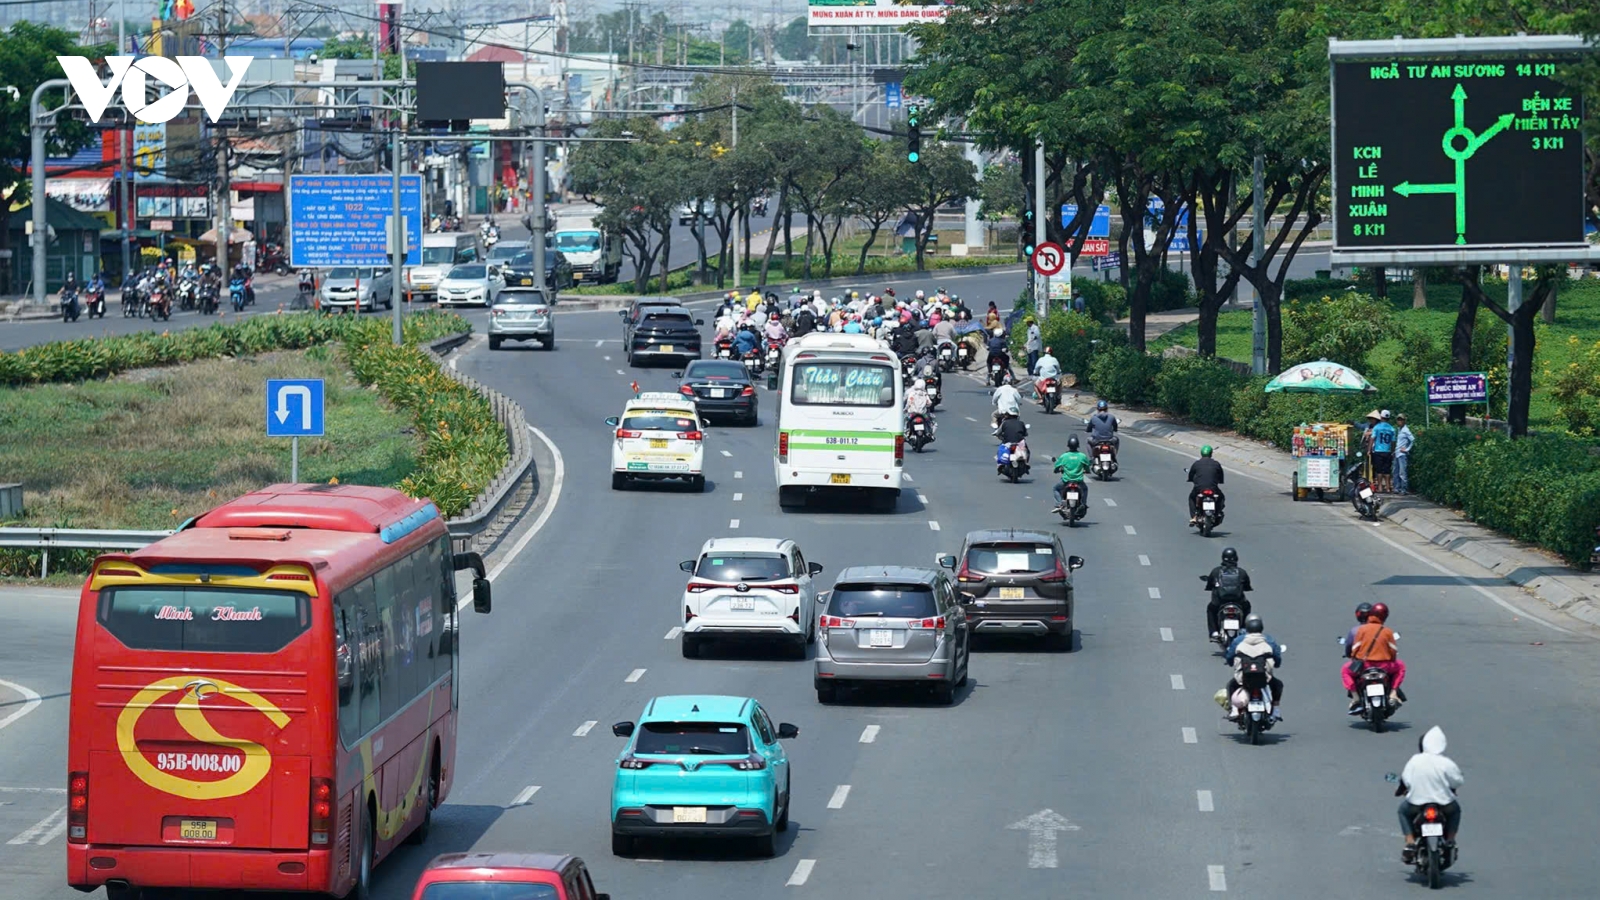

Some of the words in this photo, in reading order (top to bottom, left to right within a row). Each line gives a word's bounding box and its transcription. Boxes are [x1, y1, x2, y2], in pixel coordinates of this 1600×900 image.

[1370, 63, 1400, 79] NGÃ
[1407, 64, 1428, 78] TƯ
[1431, 66, 1451, 78] AN
[1455, 64, 1506, 78] SƯƠNG
[1516, 64, 1531, 76] 14
[1535, 64, 1555, 76] KM
[1522, 90, 1550, 111] BẾN
[1554, 98, 1572, 110] XE
[1515, 111, 1548, 130] MIỀN
[1552, 114, 1580, 129] TÂY
[1532, 138, 1540, 149] 3
[1544, 137, 1564, 149] KM
[1353, 146, 1382, 158] KCN
[1358, 162, 1378, 178] LÊ
[1351, 184, 1384, 197] MINH
[1348, 200, 1387, 216] XUÂN
[1353, 224, 1361, 236] 8
[1365, 224, 1385, 236] KM
[1096, 242, 1107, 252] SÁT
[806, 366, 838, 383] Thảo
[845, 370, 883, 387] Châu
[1453, 383, 1467, 391] BÌNH
[1380, 433, 1391, 444] 10
[154, 606, 193, 620] Minh
[212, 606, 262, 621] Khanh
[157, 752, 240, 772] 95B-008.00
[190, 821, 206, 829] 95B
[184, 829, 213, 838] 008.00
